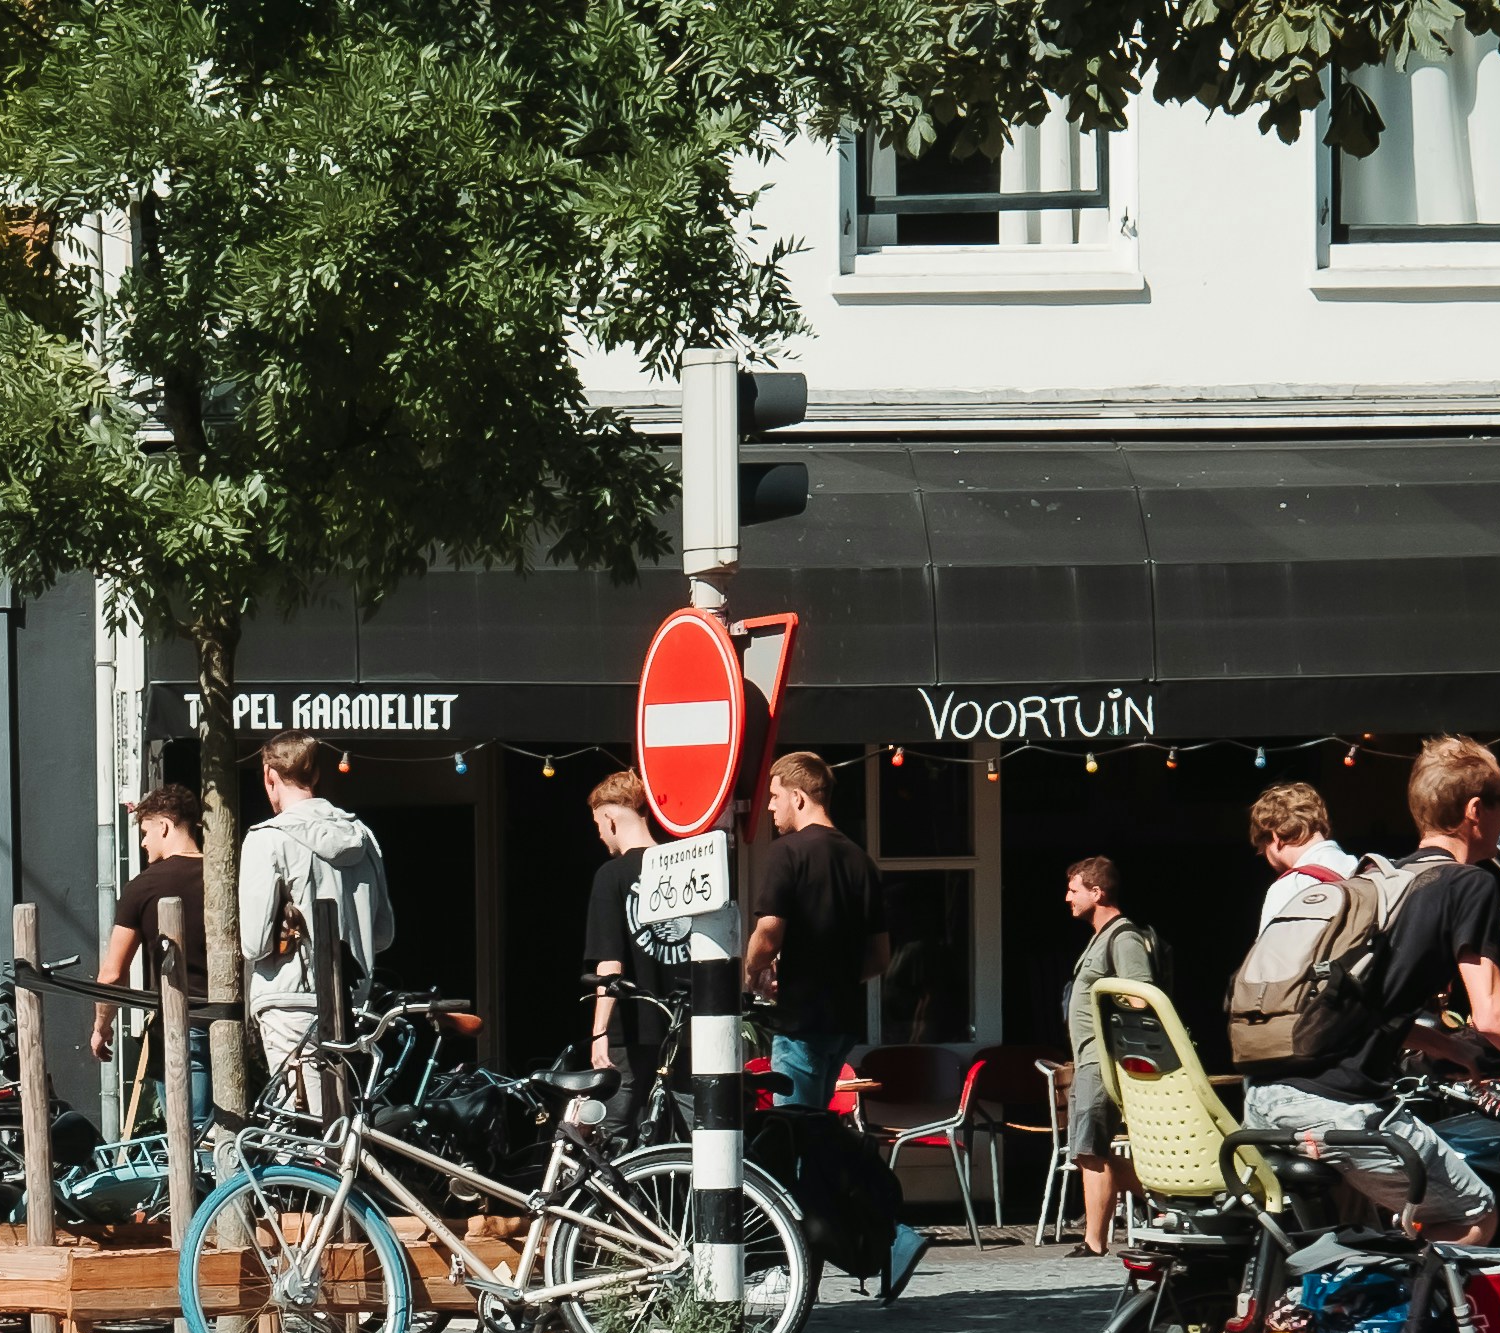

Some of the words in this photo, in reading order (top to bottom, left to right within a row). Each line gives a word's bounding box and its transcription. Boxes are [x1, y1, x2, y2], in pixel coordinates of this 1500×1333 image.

[183, 693, 283, 730] TPEL
[292, 693, 460, 731] KARMELIET
[917, 688, 1155, 740] VOORTUIN
[651, 840, 715, 872] tgezonderd
